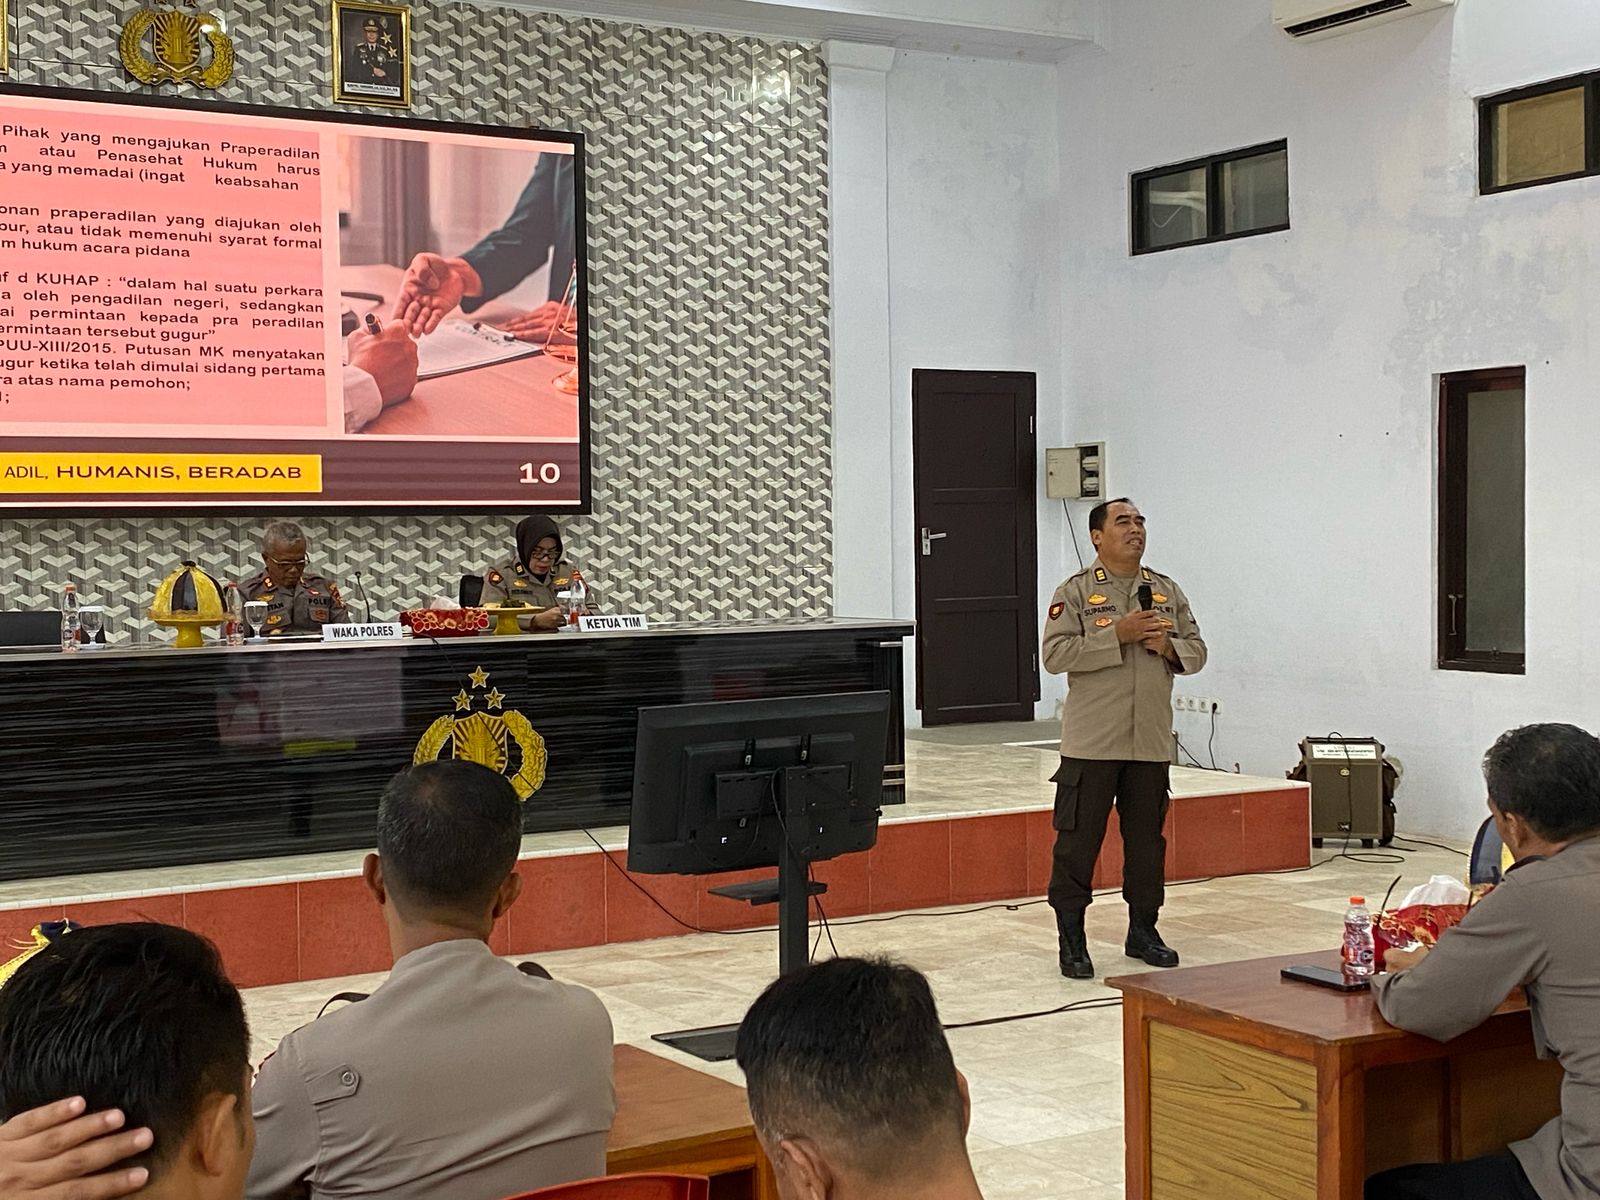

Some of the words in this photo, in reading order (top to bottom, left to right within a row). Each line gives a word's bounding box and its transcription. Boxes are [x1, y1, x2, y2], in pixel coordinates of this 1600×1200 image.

[2, 124, 50, 139] Pihak
[60, 131, 101, 146] yang
[112, 135, 210, 152] mengajukan
[220, 141, 320, 160] Praperadilan
[39, 145, 76, 158] atau
[97, 149, 184, 166] Penasehat
[203, 156, 258, 172] Hukum
[277, 162, 321, 176] harus
[11, 162, 53, 177] yang
[57, 165, 134, 179] memadai
[138, 168, 185, 184] (ingat
[215, 173, 299, 191] keabsahan
[50, 208, 157, 223] praperadilan
[166, 215, 205, 229] yang
[214, 216, 280, 231] diajukan
[289, 221, 322, 233] oleh
[36, 222, 74, 235] atau
[80, 224, 122, 238] tidak
[128, 230, 212, 243] memenuhi
[218, 235, 268, 247] syarat
[273, 235, 322, 249] formal
[21, 237, 78, 252] hukum
[82, 244, 130, 255] acara
[135, 244, 190, 258] pidana
[17, 272, 28, 284] d
[36, 272, 99, 287] KUHAP
[119, 276, 176, 290] “dalam
[183, 279, 207, 292] hal
[214, 282, 257, 294] suatu
[264, 284, 323, 298] perkara
[23, 289, 59, 302] oleh
[71, 293, 162, 307] pengadilan
[173, 297, 229, 311] negeri,
[239, 299, 324, 315] sedangkan
[29, 308, 126, 321] permintaan
[140, 310, 199, 326] kepada
[212, 316, 239, 328] pra
[252, 317, 324, 329] peradilan
[86, 325, 157, 339] tersebut
[160, 329, 216, 343] gugur”
[125, 343, 191, 356] Putusan
[199, 345, 225, 357] MK
[232, 348, 325, 362] menyatakan
[40, 357, 90, 370] ketika
[94, 359, 136, 371] telah
[140, 360, 199, 373] dimulai
[203, 362, 256, 377] sidang
[261, 365, 326, 378] pertama
[18, 374, 54, 386] atas
[59, 377, 105, 387] nama
[110, 377, 191, 391] pemohon;
[4, 466, 49, 481] ADIL,
[57, 465, 181, 481] HUMANIS,
[189, 466, 302, 479] BERADAB
[519, 462, 561, 484] 10
[332, 626, 359, 639] WAKA
[361, 624, 394, 638] POLRES
[586, 617, 621, 630] KETUA
[622, 616, 641, 629] TIM
